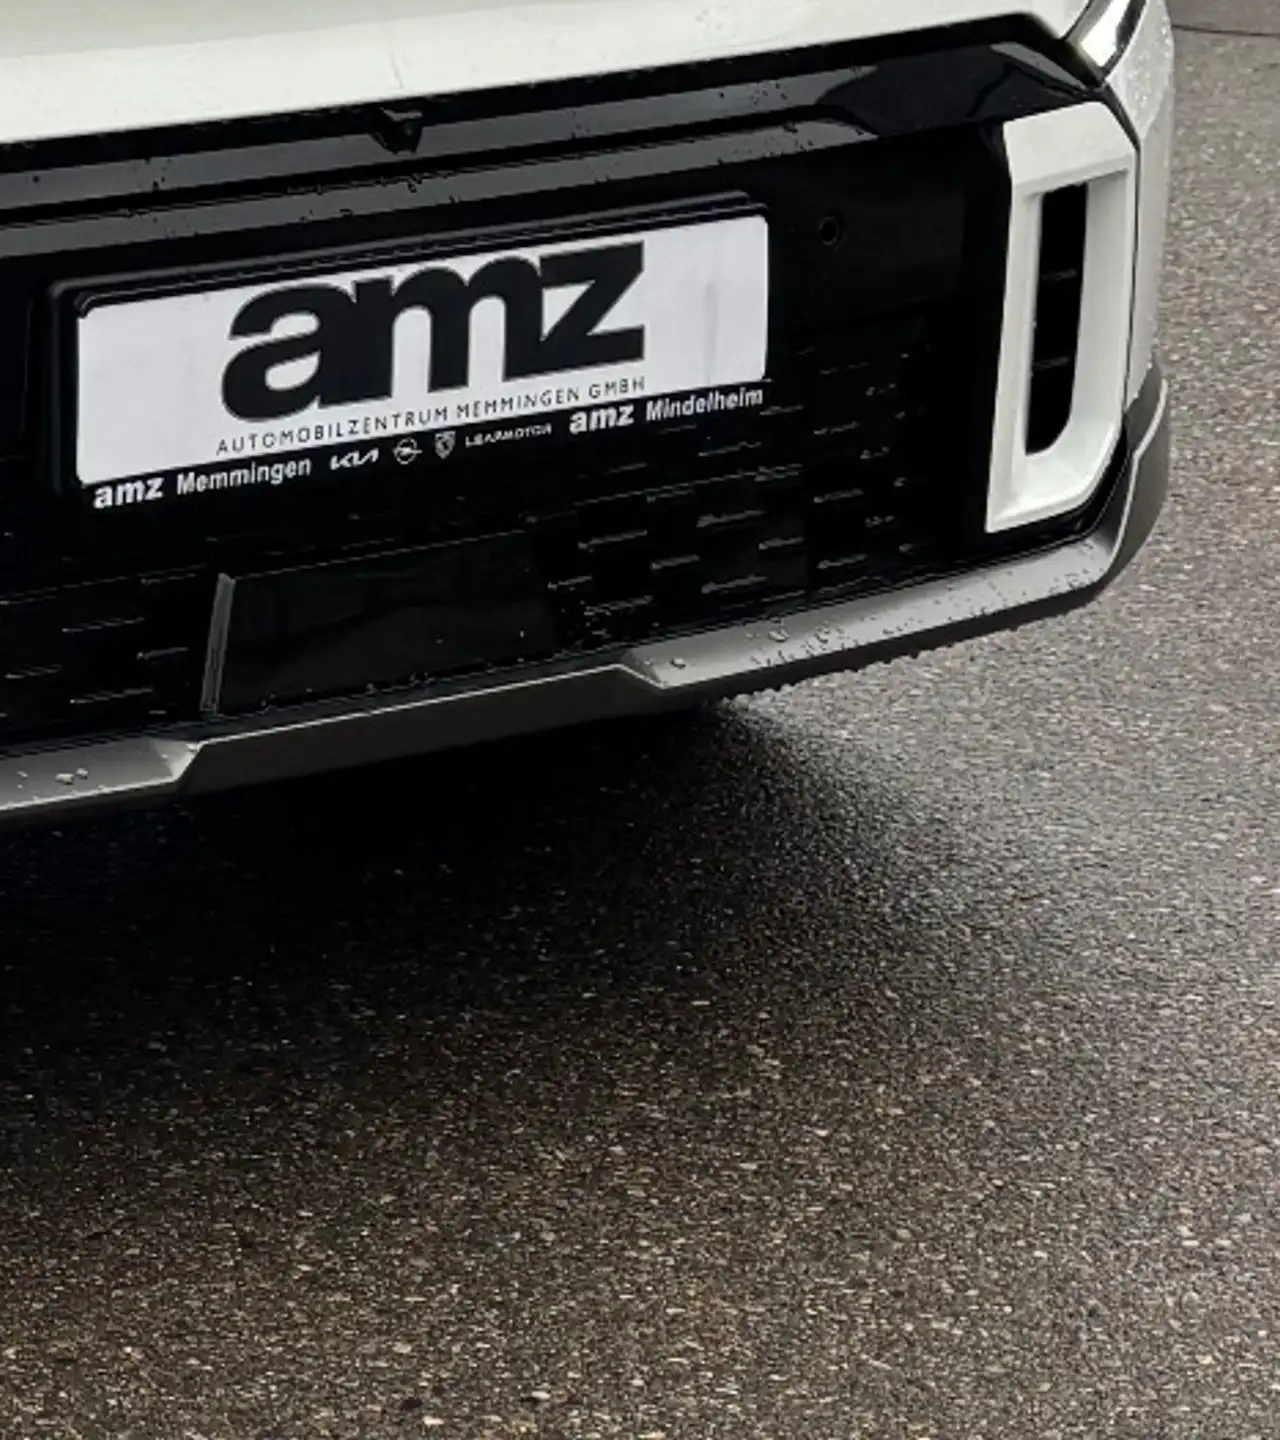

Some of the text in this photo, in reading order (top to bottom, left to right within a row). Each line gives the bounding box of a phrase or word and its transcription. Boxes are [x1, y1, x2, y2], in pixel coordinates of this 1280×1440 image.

[221, 239, 645, 422] amz
[93, 476, 164, 509] amz
[176, 458, 312, 496] Memmingen
[569, 403, 635, 435] amz
[645, 388, 764, 423] Mindelheim
[216, 375, 646, 456] AUTOMOBILZENTRUM MEMMINGEN GMBH
